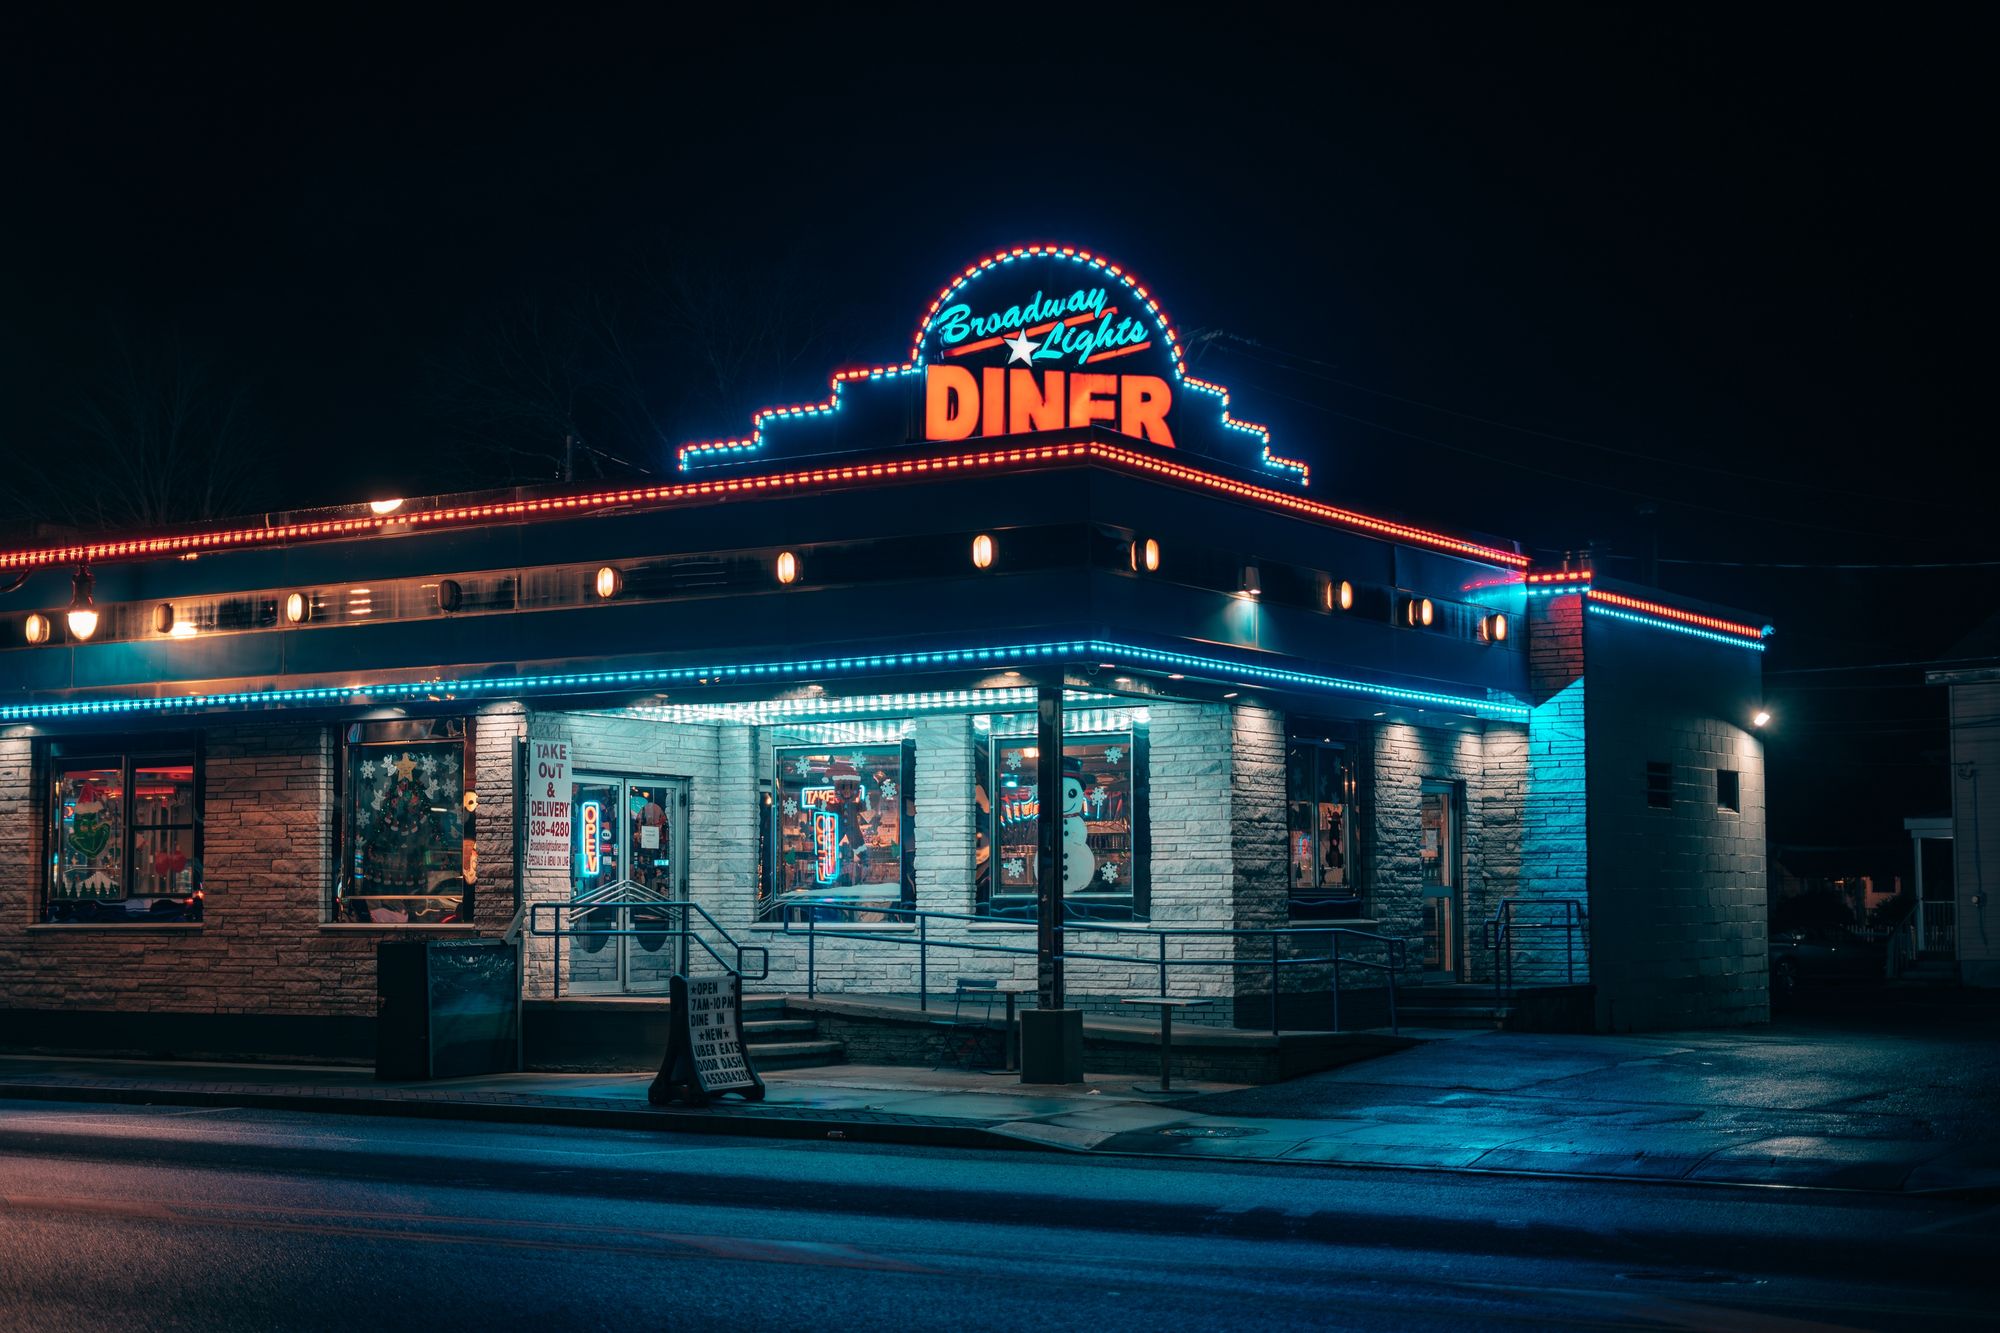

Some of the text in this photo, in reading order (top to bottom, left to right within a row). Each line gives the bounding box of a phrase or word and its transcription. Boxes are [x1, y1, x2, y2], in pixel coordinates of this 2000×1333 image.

[938, 289, 1106, 343] Broadway
[1032, 312, 1147, 364] Lights
[926, 364, 1175, 448] DINER
[537, 744, 567, 759] TAKE
[539, 762, 563, 778] OUT
[547, 782, 555, 797] &
[806, 790, 836, 804] TAKE
[532, 801, 570, 817] DELIVERY
[531, 820, 569, 837] 338-4280
[585, 806, 597, 872] OPEN
[697, 981, 718, 995] OPEN
[691, 1012, 725, 1027] DINE IN
[705, 1028, 722, 1041] NEW
[694, 1041, 741, 1057] UBER EATS
[697, 1056, 744, 1071] DOOR DASH
